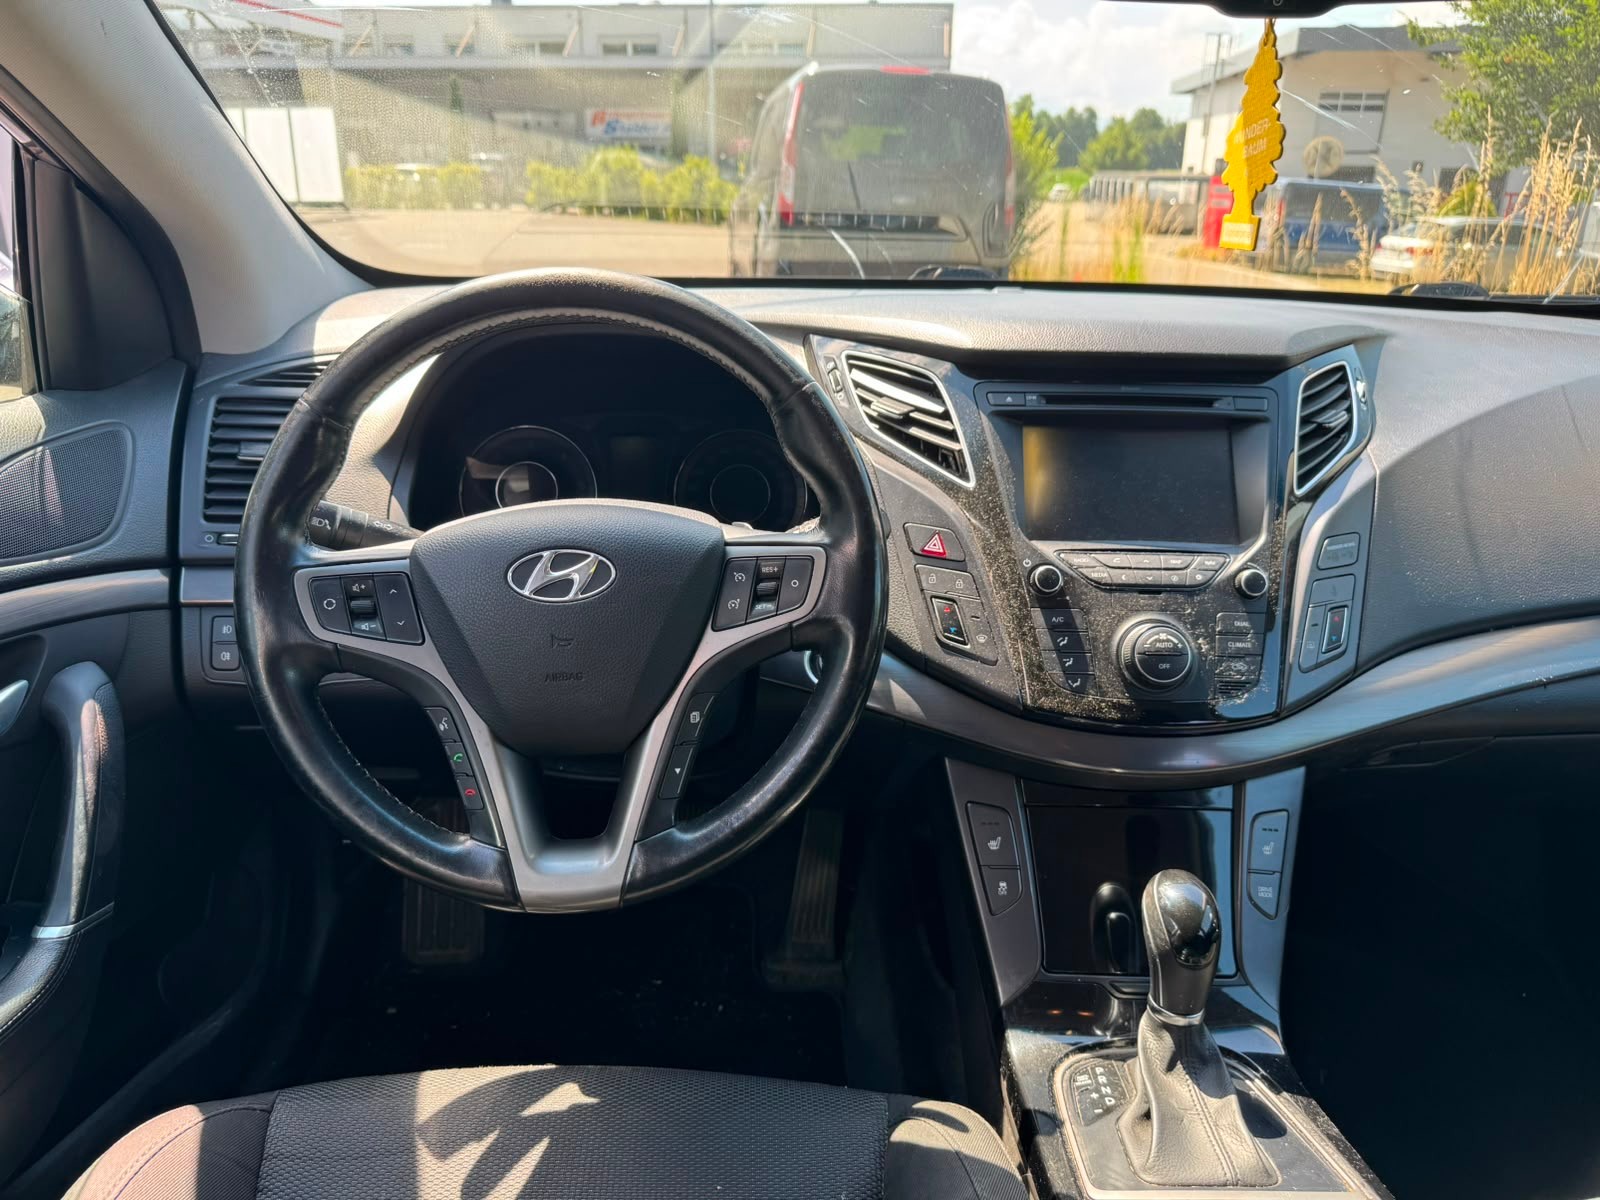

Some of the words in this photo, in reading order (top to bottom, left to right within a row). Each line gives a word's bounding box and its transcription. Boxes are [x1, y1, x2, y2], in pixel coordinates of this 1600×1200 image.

[1243, 137, 1268, 158] BAUM
[544, 671, 583, 682] AIRBAG
[1095, 1066, 1104, 1075] P
[1097, 1075, 1107, 1084] R
[1101, 1086, 1112, 1095] N
[1104, 1097, 1116, 1106] D
